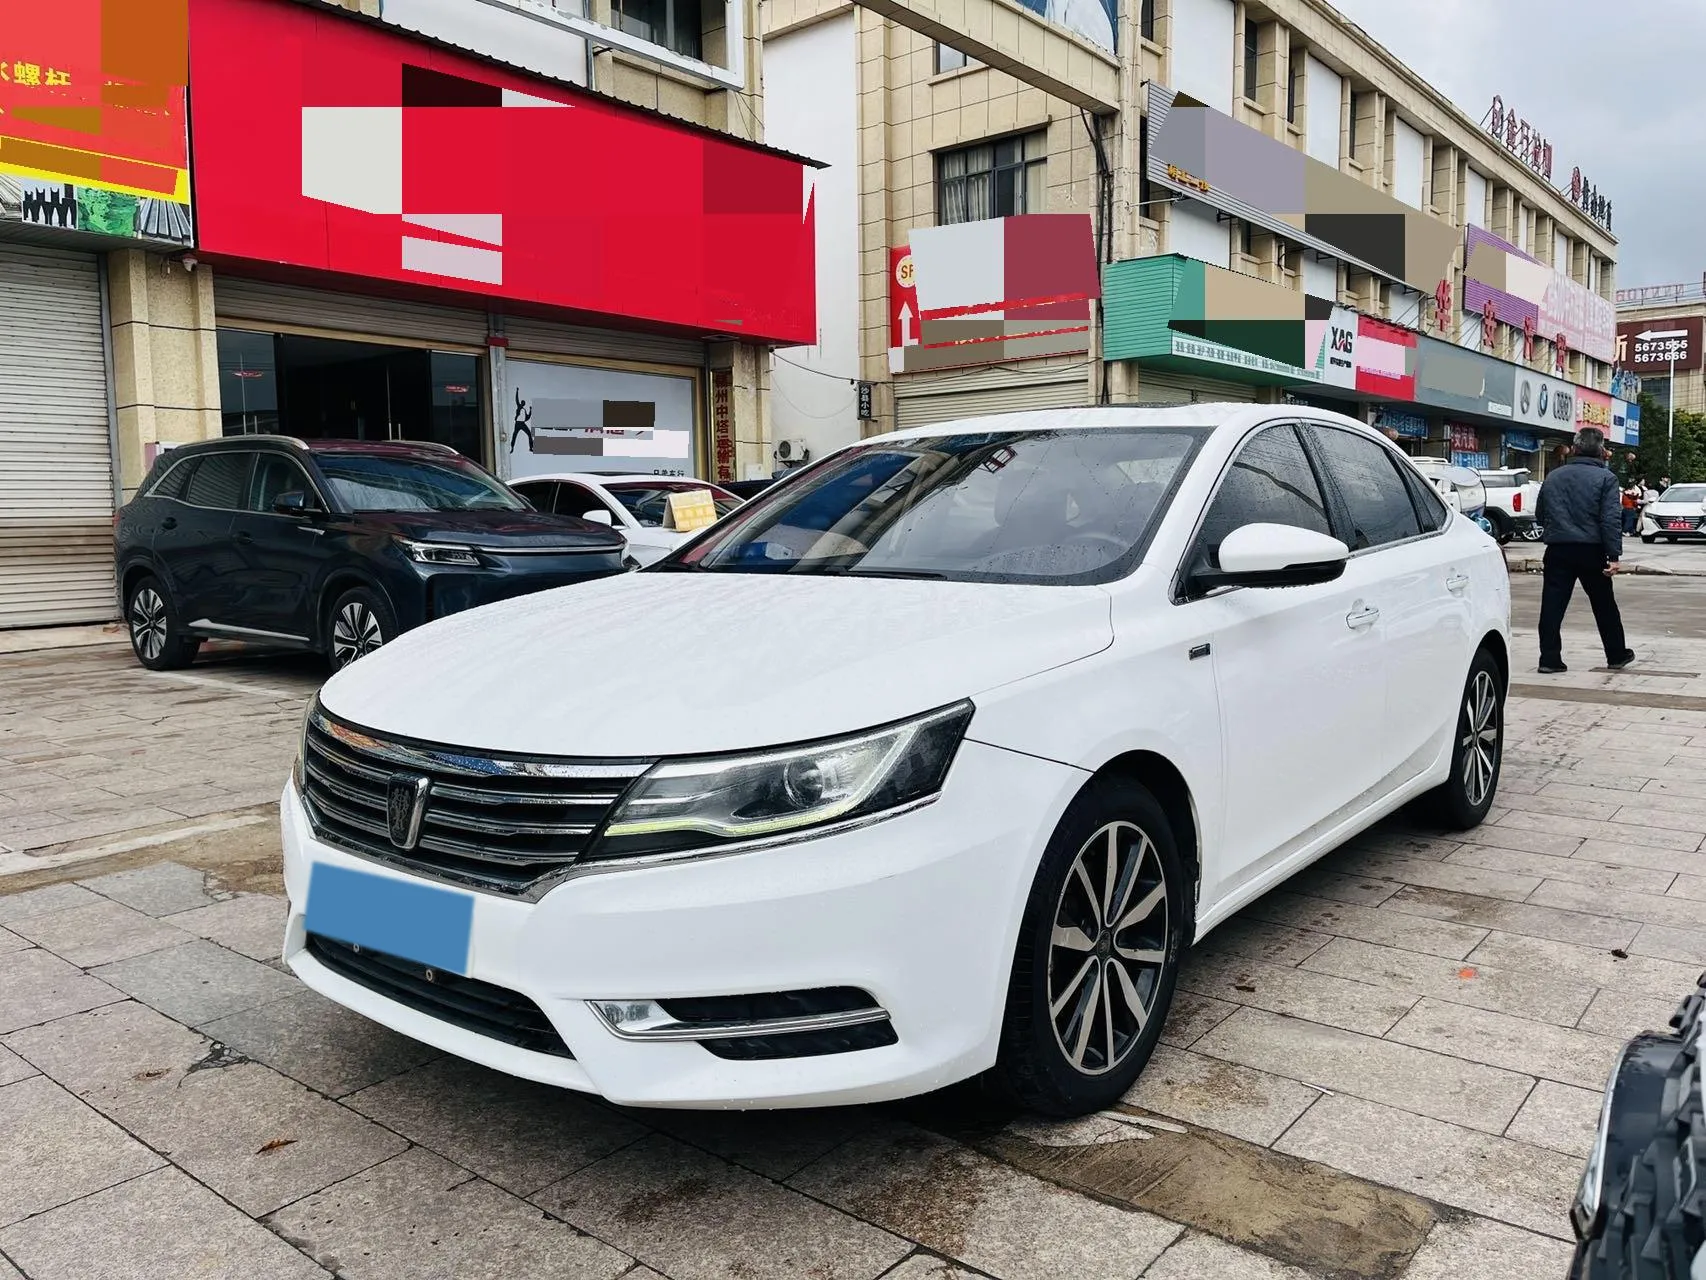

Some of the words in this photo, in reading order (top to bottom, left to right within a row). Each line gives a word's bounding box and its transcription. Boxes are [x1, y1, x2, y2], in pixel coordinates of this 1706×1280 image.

[1331, 326, 1353, 354] XAG
[1634, 340, 1688, 352] 5673555
[1634, 351, 1688, 363] 5673666
